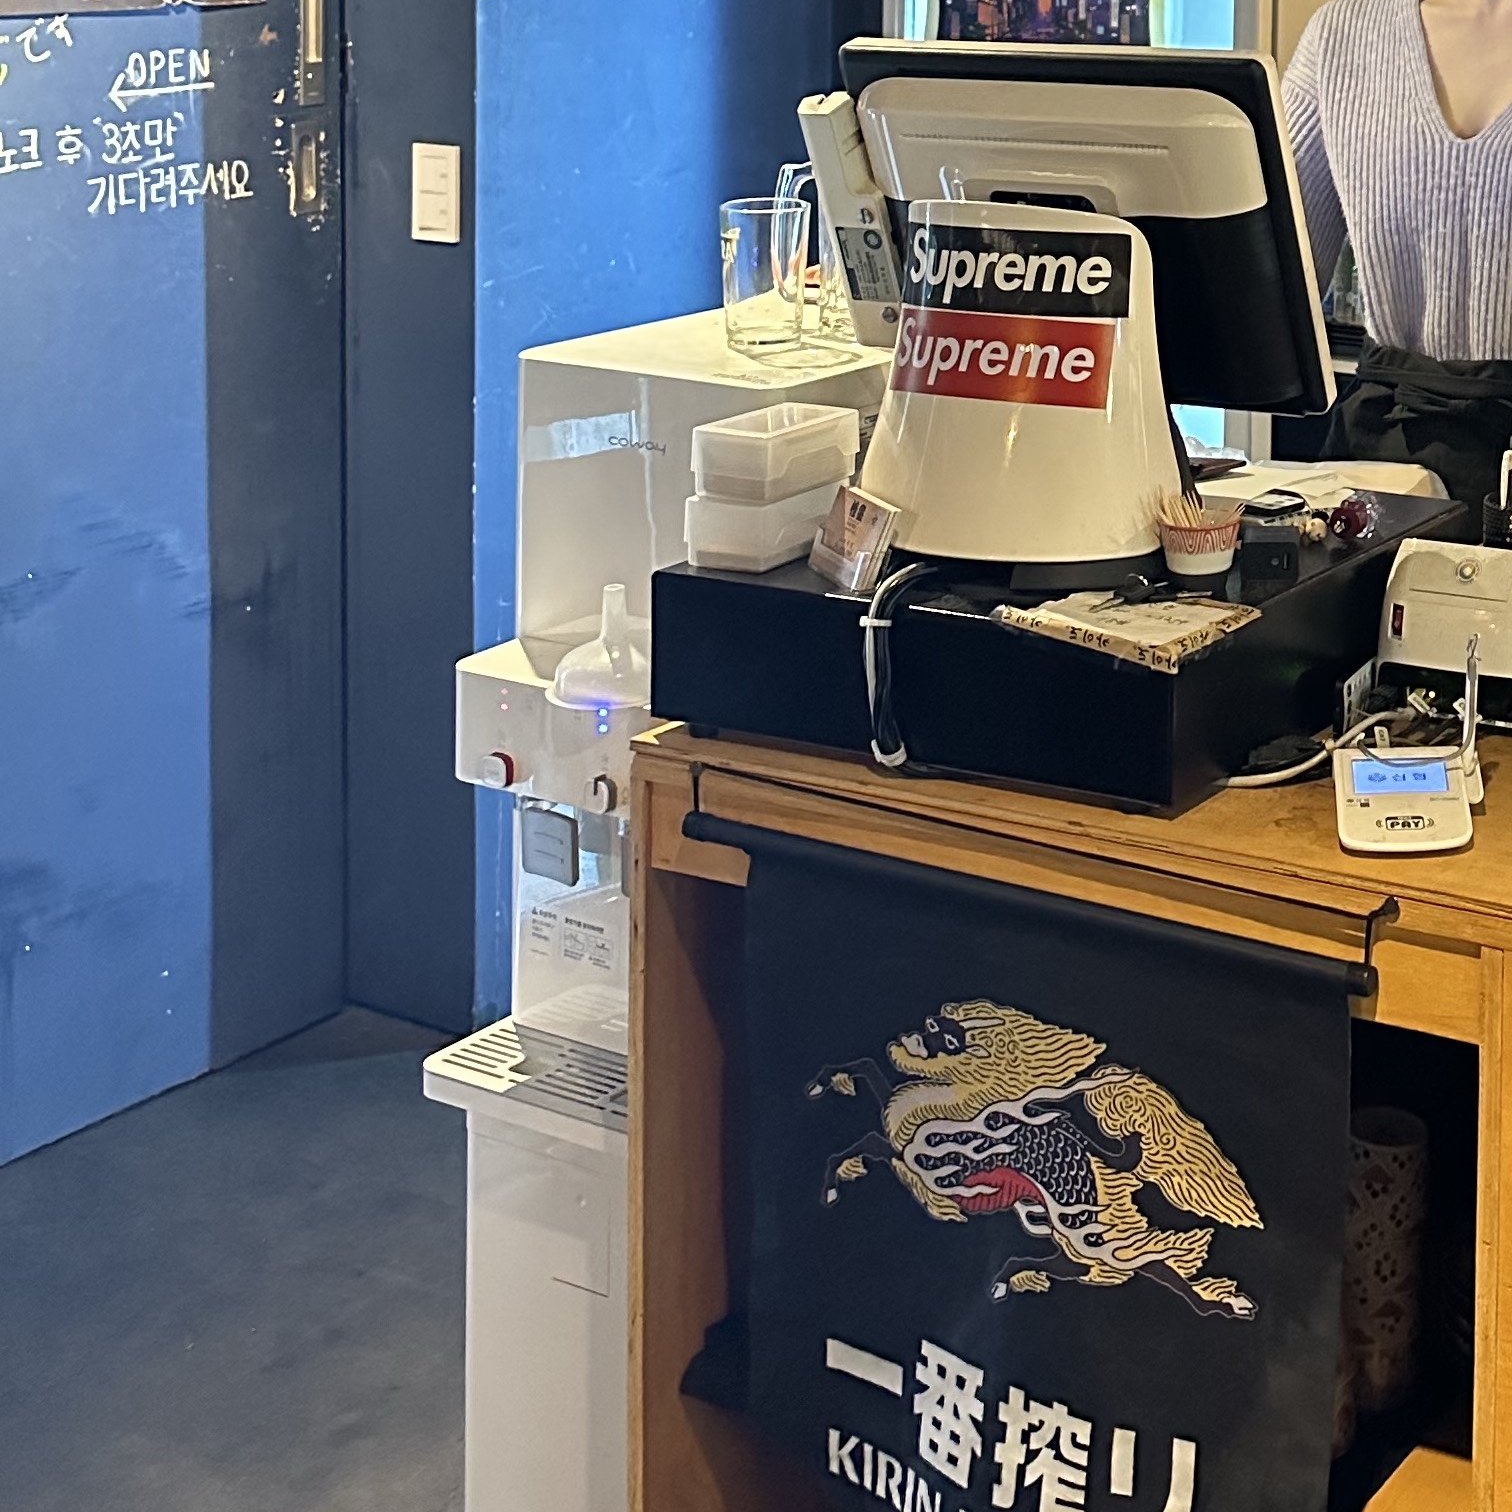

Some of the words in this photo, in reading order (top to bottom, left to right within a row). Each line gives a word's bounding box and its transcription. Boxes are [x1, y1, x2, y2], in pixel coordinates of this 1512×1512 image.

[126, 48, 211, 88] OPEN
[55, 124, 83, 165] 후
[86, 159, 254, 215] 기다려주세요
[910, 227, 1112, 304] Supreme
[900, 317, 1095, 386] Supreme
[608, 425, 667, 456] coway
[825, 1338, 1197, 1512] 一番搾り
